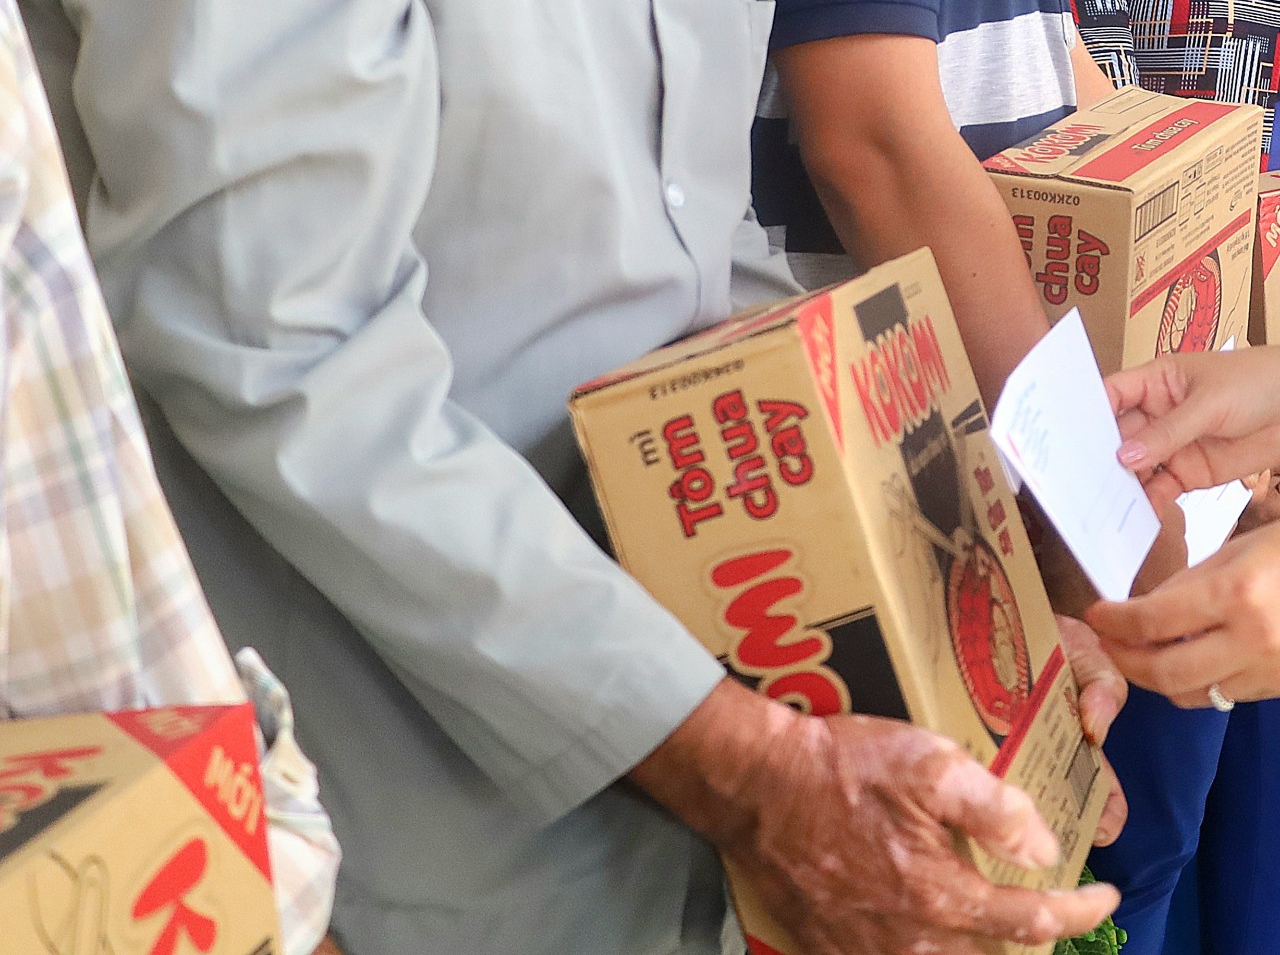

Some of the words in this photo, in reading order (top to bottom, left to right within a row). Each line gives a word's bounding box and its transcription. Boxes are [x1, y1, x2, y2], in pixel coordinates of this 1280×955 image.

[1015, 124, 1105, 164] KOKOMI
[1012, 187, 1080, 206] 02KK00313
[1036, 215, 1073, 305] chua
[1075, 229, 1110, 295] cay
[851, 314, 952, 449] KOKOMI
[711, 389, 779, 520] chua
[757, 399, 814, 487] cay
